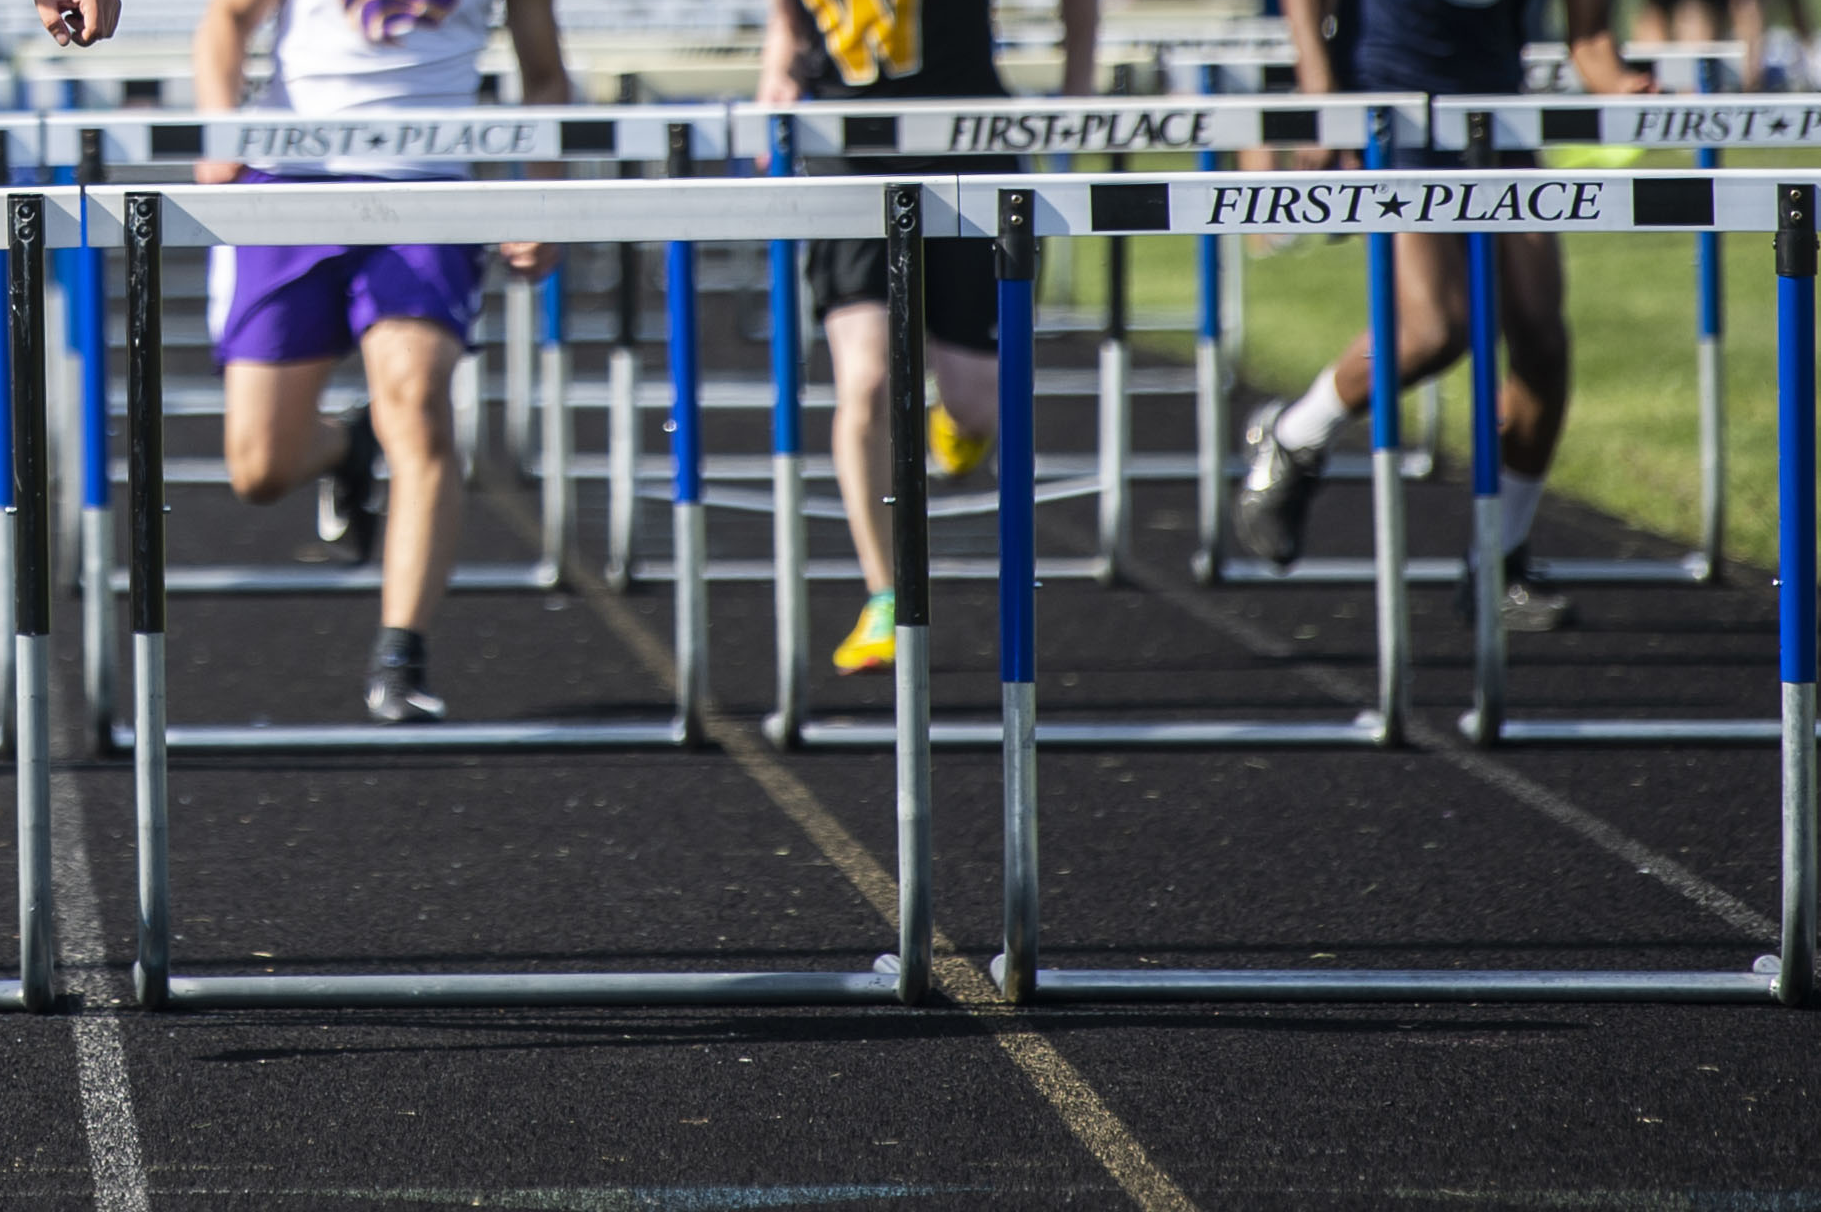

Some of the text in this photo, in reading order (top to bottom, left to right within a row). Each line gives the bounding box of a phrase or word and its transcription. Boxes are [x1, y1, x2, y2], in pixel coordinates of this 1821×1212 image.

[236, 123, 538, 158] FIRST PLACE
[948, 110, 1215, 152] FIRST PLACE
[1630, 107, 1769, 142] FIRST
[1205, 181, 1603, 225] FIRST PLACE
